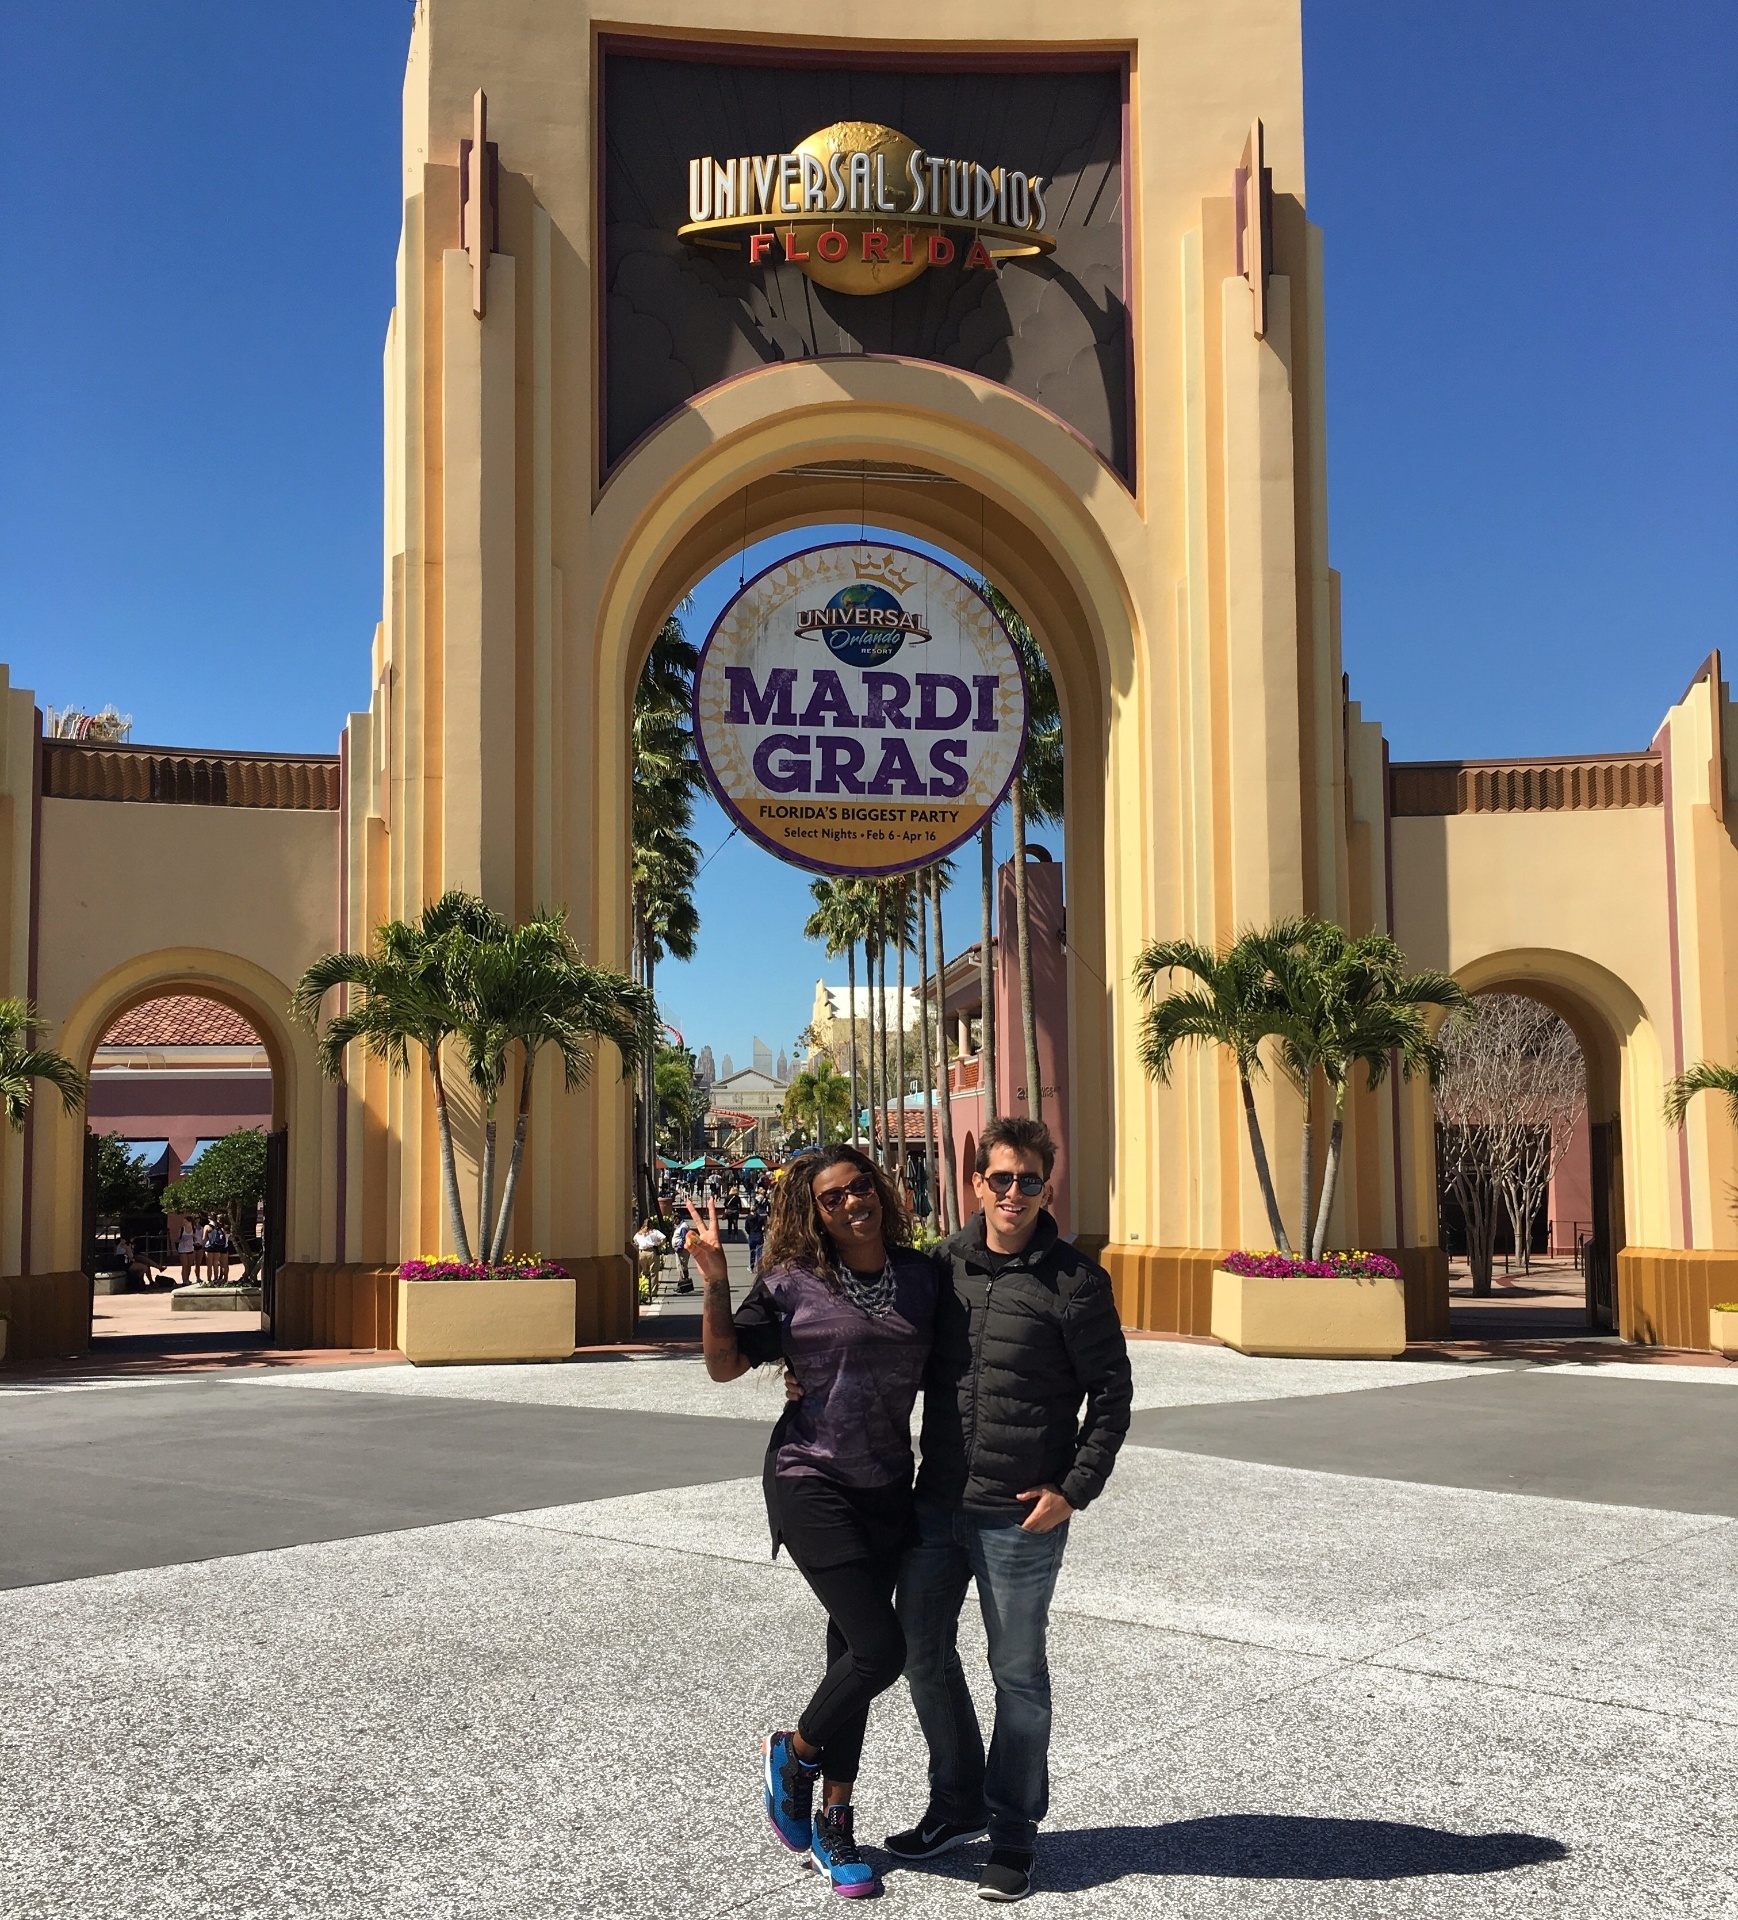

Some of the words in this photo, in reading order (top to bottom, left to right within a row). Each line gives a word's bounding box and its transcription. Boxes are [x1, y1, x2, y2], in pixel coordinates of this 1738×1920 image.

[689, 151, 896, 222] UNIVERSAL
[909, 148, 1049, 231] STUDIOS
[749, 229, 995, 270] FLORIDA
[797, 608, 929, 633] UNIVERSAL
[829, 628, 901, 650] Orlando
[724, 666, 1000, 732] MARDI
[753, 733, 969, 798] GRAS
[759, 805, 838, 820] FLORIDA'S
[841, 808, 907, 822] BIGGEST
[910, 810, 959, 823] PARTY
[784, 827, 818, 838] Select
[821, 828, 858, 842] Nights
[866, 830, 885, 841] Feb
[888, 830, 895, 841] 6
[902, 831, 922, 844] Apr
[924, 831, 936, 842] 16
